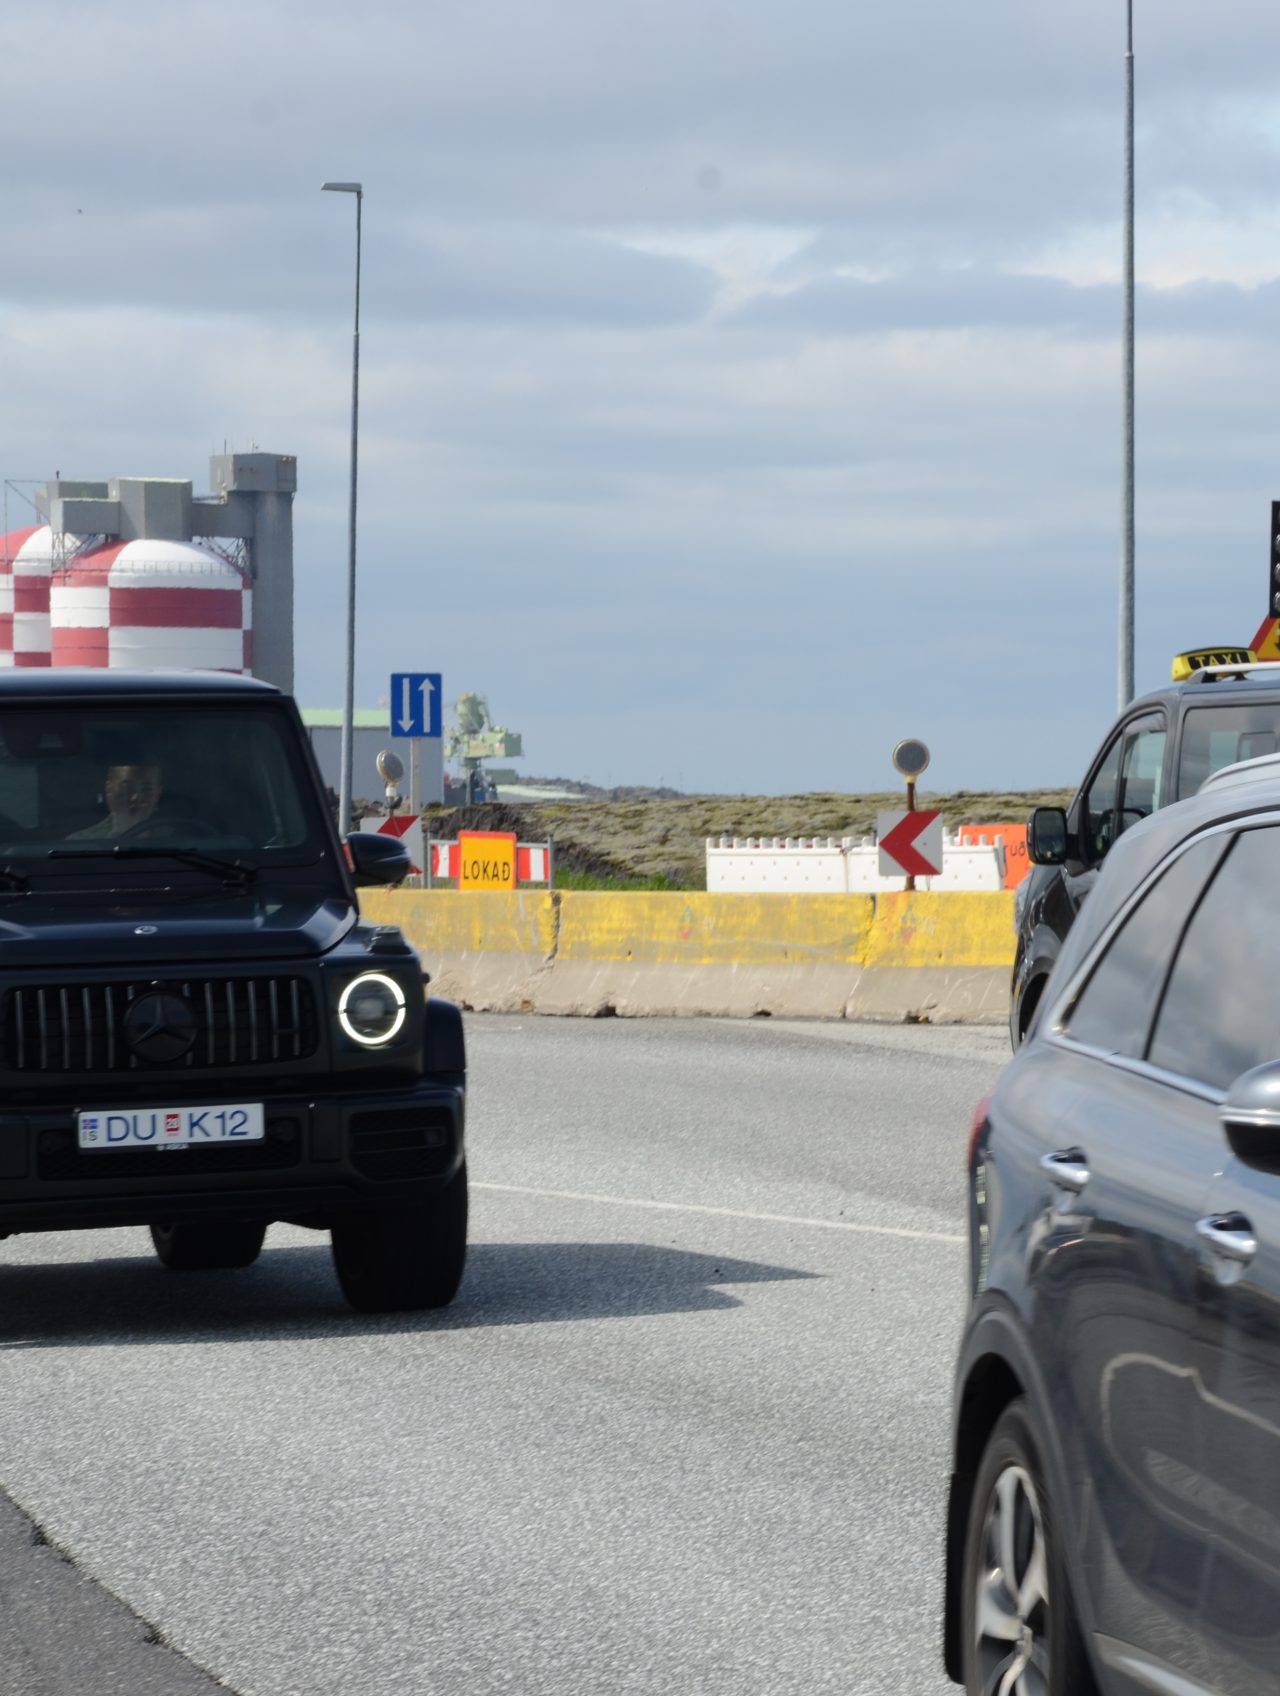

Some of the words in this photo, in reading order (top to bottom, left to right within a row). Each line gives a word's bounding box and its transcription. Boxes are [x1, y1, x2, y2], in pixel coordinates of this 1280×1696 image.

[1194, 653, 1243, 668] TAXI
[463, 860, 511, 881] LOKAÐ
[106, 1114, 156, 1142] DU
[188, 1110, 248, 1138] K12
